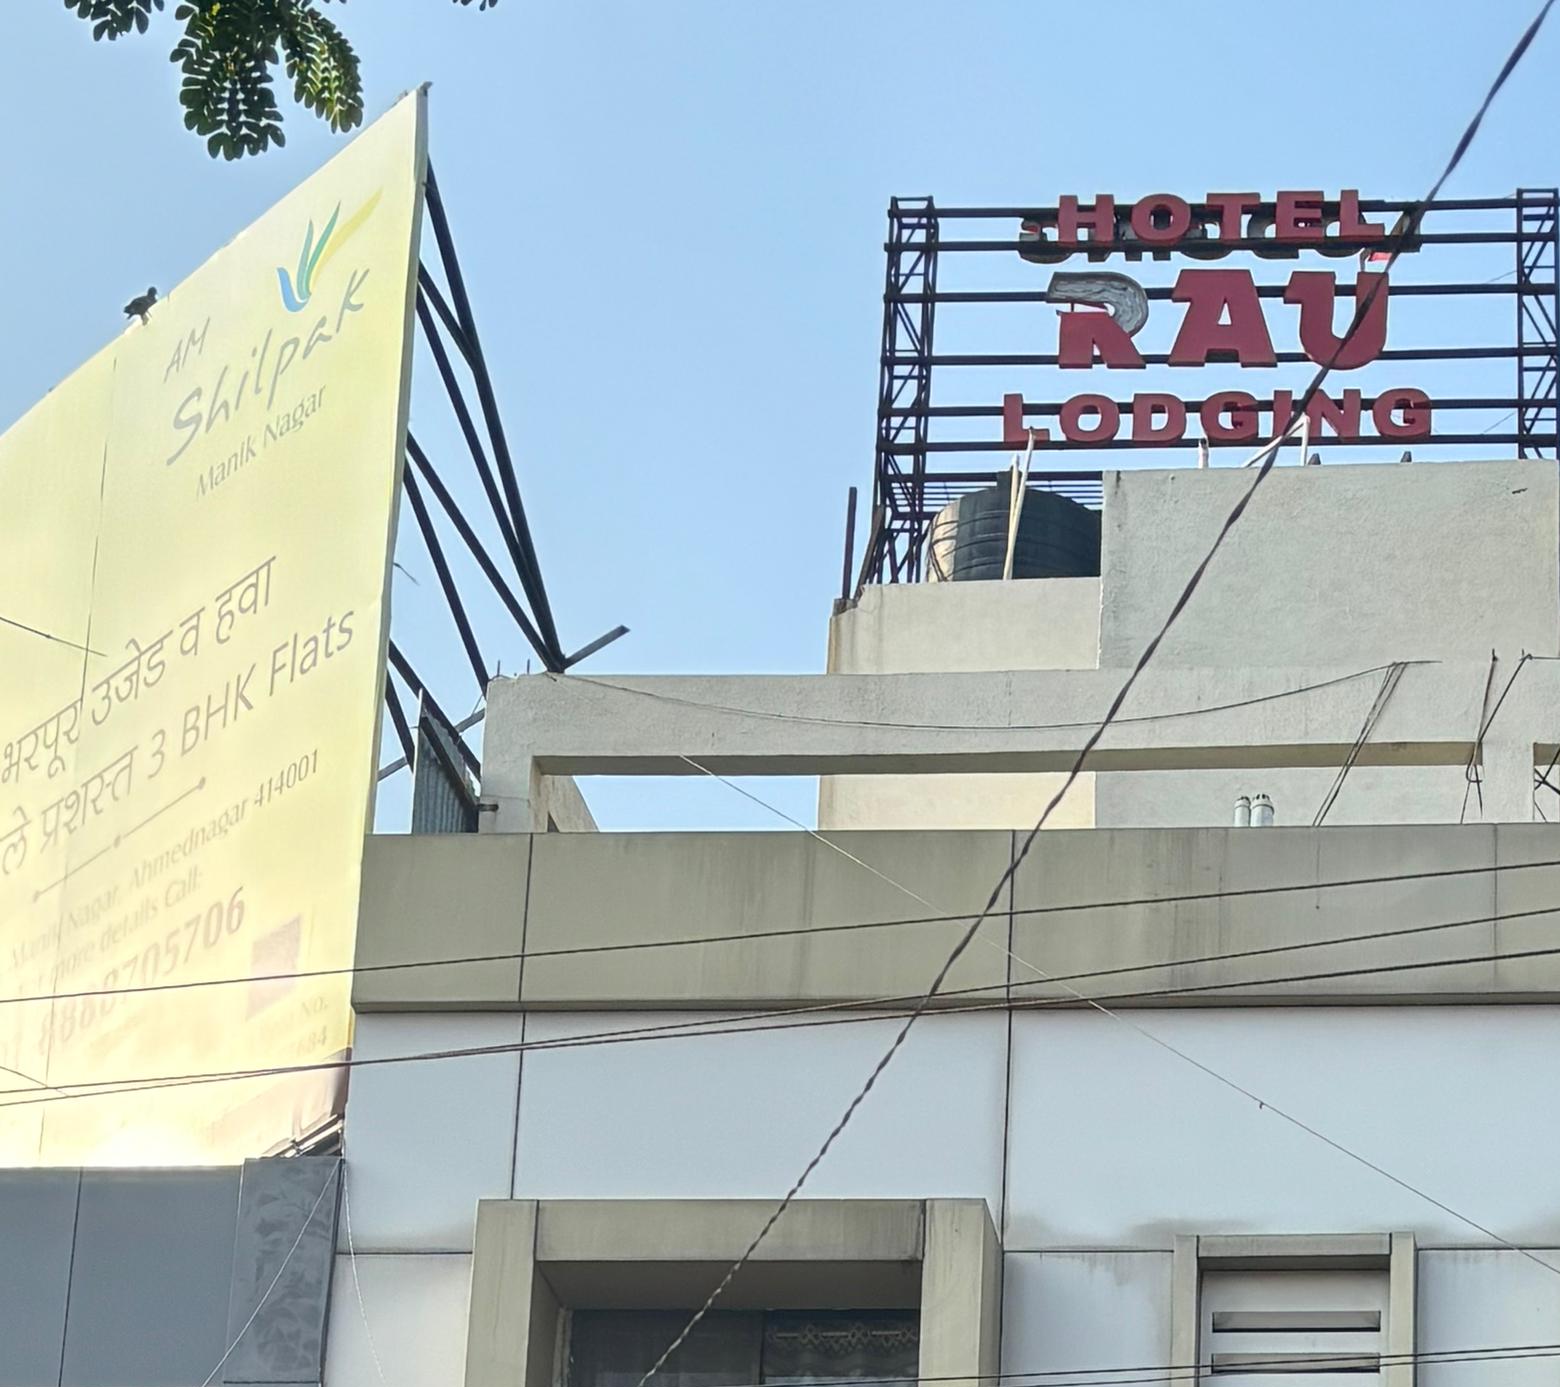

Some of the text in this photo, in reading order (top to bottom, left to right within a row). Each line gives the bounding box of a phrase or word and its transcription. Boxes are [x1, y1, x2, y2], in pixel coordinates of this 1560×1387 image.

[1056, 189, 1387, 247] HOTEL
[164, 317, 210, 384] AM
[166, 268, 370, 466] Shilpak
[1046, 268, 1390, 371] RAU
[197, 384, 326, 498] Manik Nagar
[1002, 388, 1433, 447] LODGING
[91, 638, 173, 726] उजेड
[180, 607, 206, 656] व
[215, 556, 276, 644] हवा
[41, 745, 139, 852] प्रशस्त
[180, 663, 256, 757] BHK
[269, 610, 354, 697] Flats
[129, 798, 248, 892] Ahmednagar
[253, 748, 318, 808] 414001
